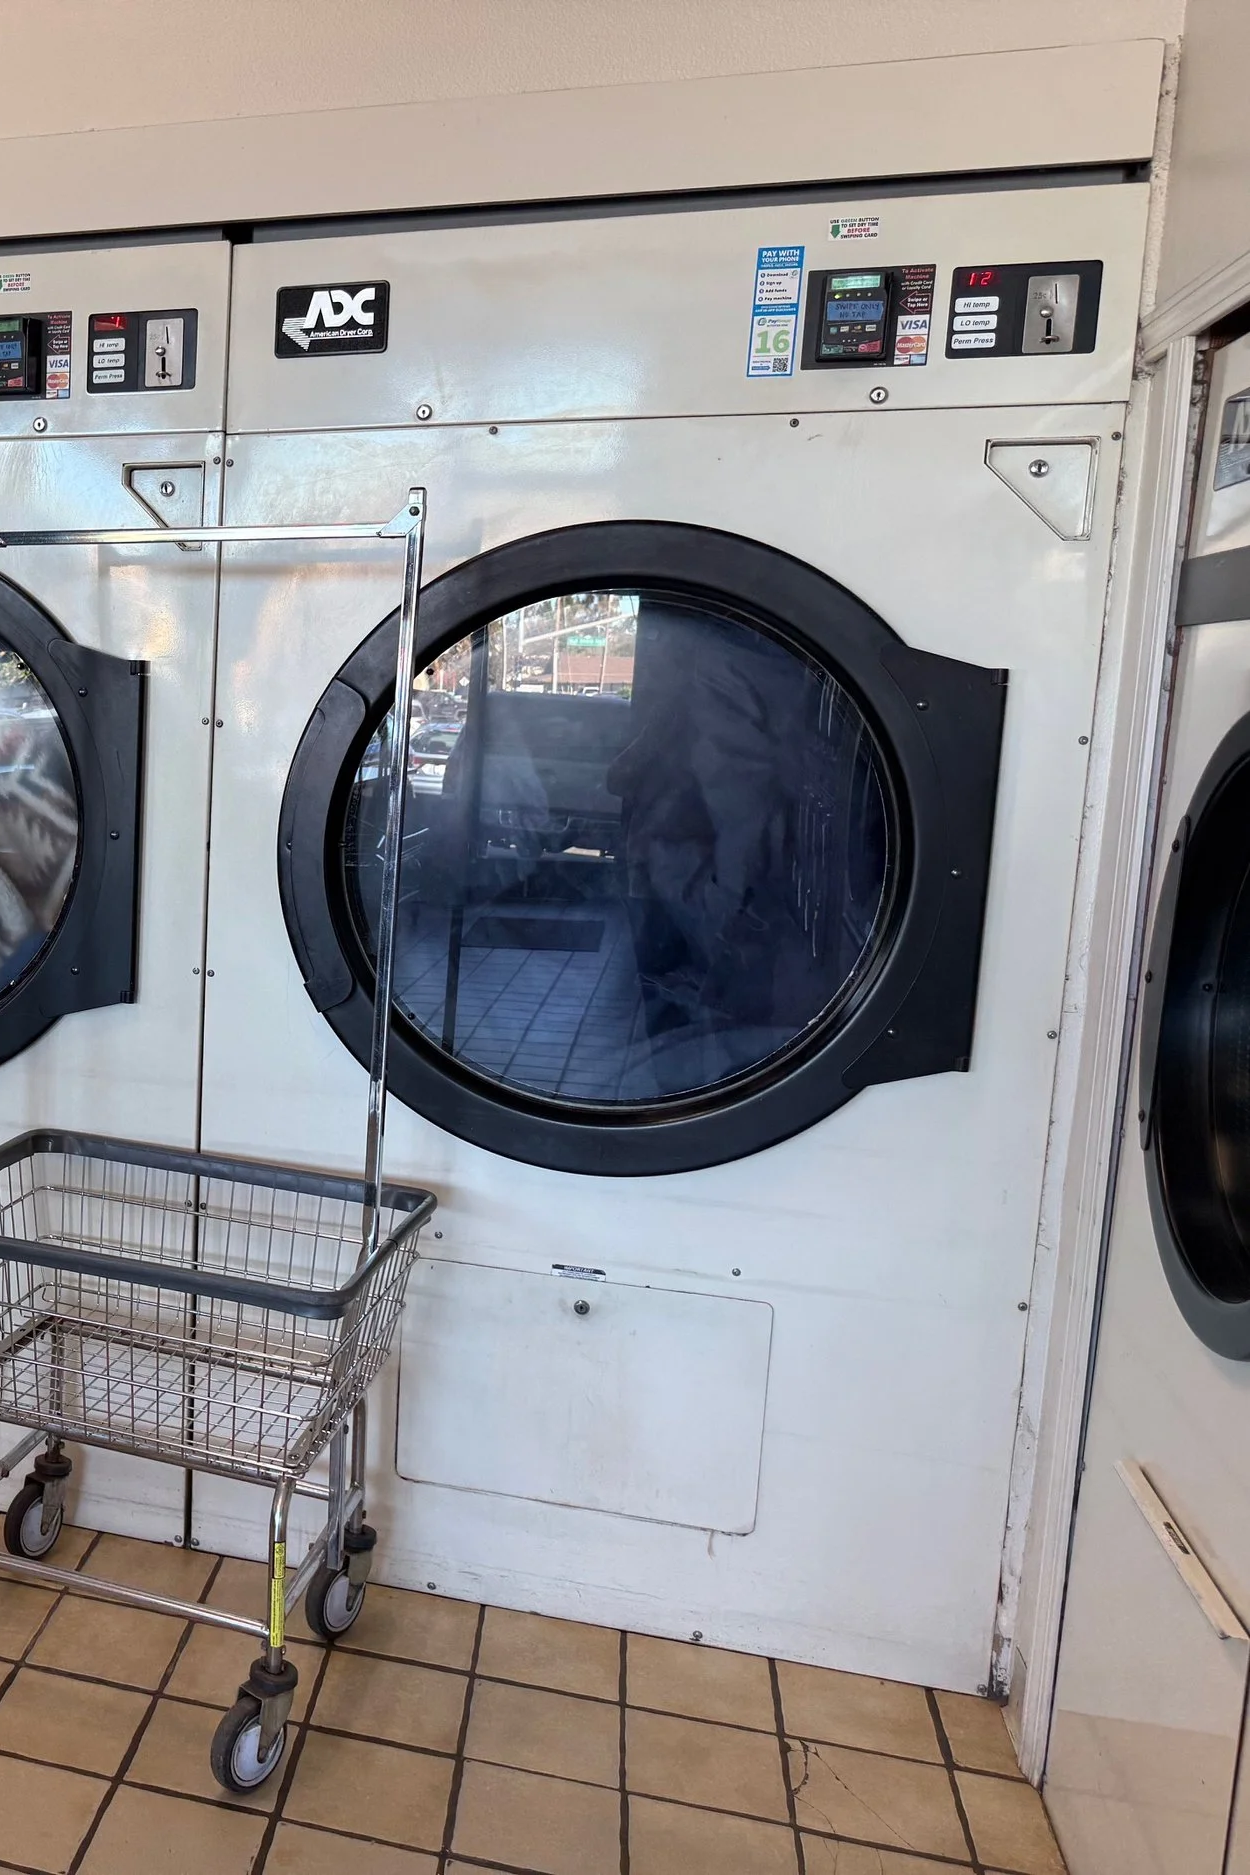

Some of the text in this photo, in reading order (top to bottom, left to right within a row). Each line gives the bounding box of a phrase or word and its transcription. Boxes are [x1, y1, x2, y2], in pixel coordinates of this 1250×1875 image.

[969, 272, 992, 286] 12
[303, 287, 375, 328] ADC
[973, 301, 990, 309] temp
[901, 320, 927, 330] VISA
[972, 319, 990, 327] temp
[755, 330, 790, 353] 16
[50, 360, 69, 368] VISA
